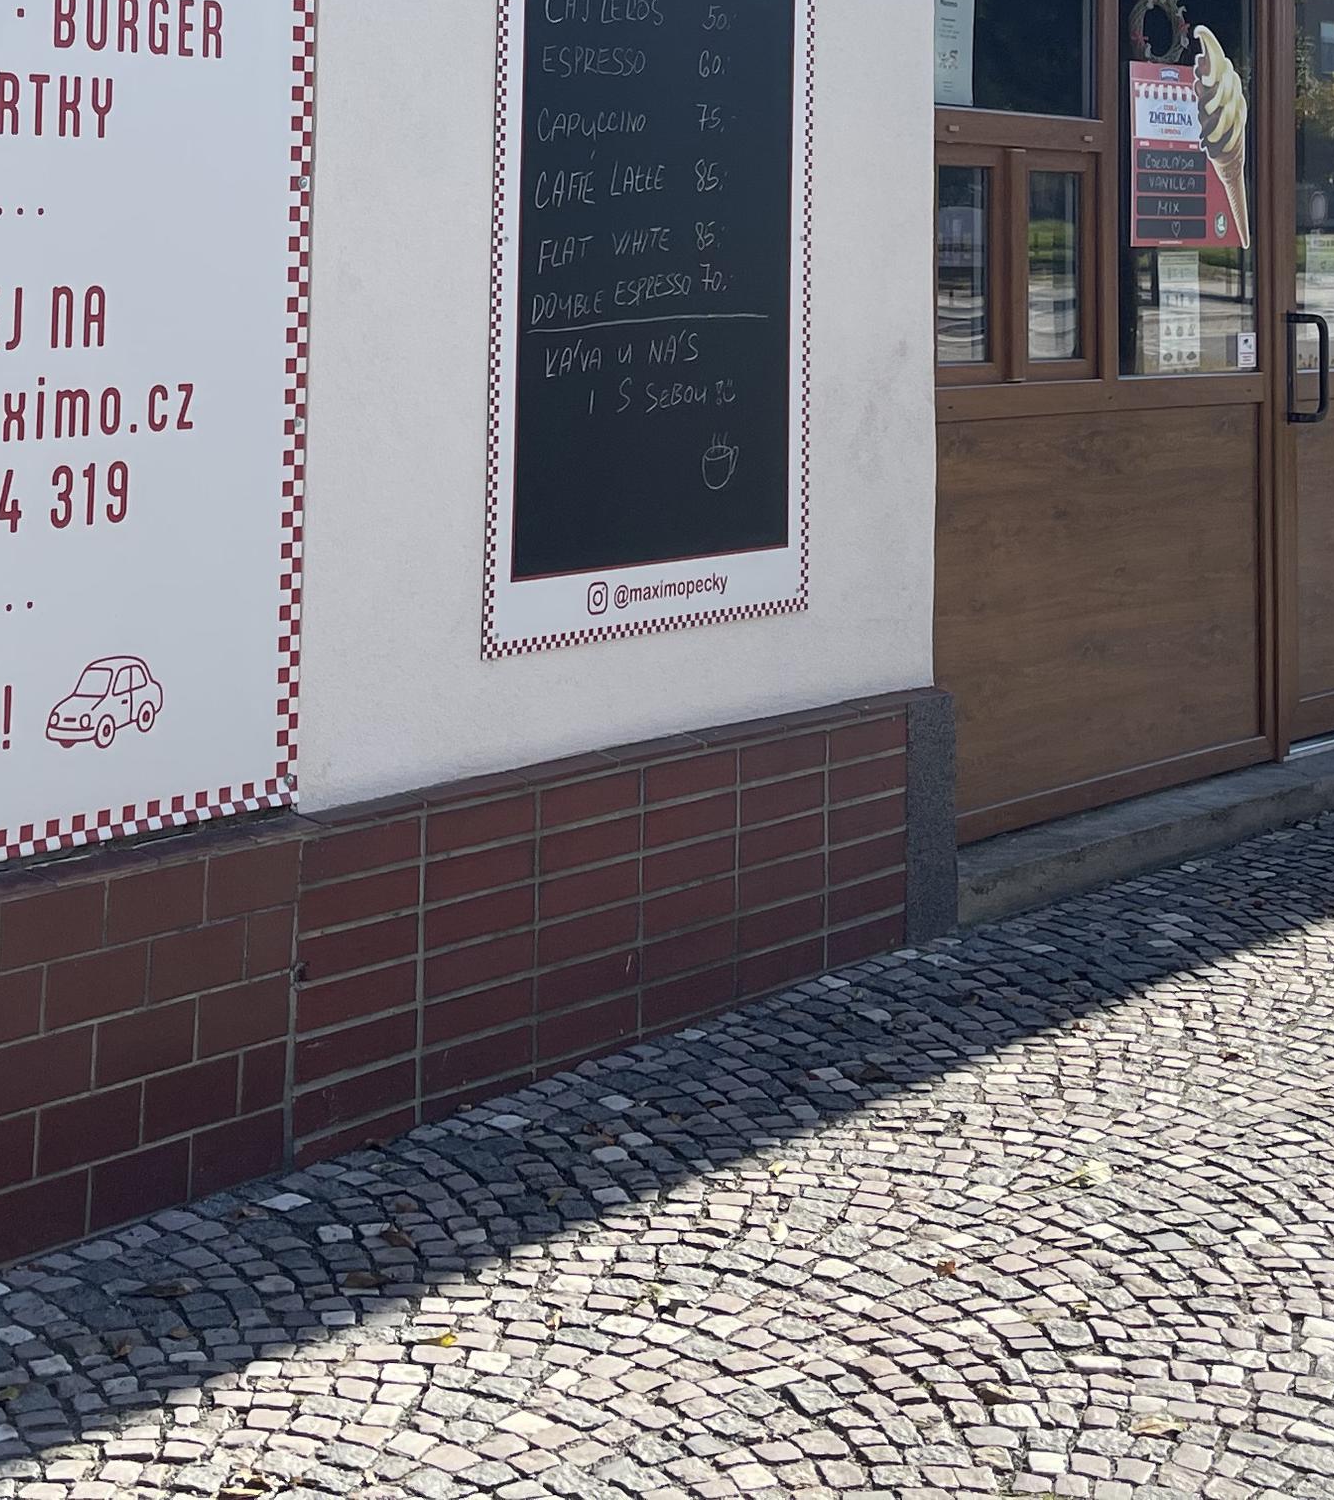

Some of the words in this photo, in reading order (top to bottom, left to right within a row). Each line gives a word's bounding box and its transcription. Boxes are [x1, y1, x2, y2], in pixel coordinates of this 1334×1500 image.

[542, 44, 646, 79] ESPRESSO
[1149, 111, 1193, 127] ZMRZLINA
[1157, 200, 1180, 216] MIX
[537, 235, 595, 275] FLAT
[612, 226, 670, 256] WHITE
[50, 283, 106, 350] NA
[530, 289, 604, 326] DOUBLE
[613, 272, 692, 306] ESPRESSO
[616, 376, 633, 414] S
[49, 459, 130, 529] 319
[613, 572, 728, 610] @maximopecky
